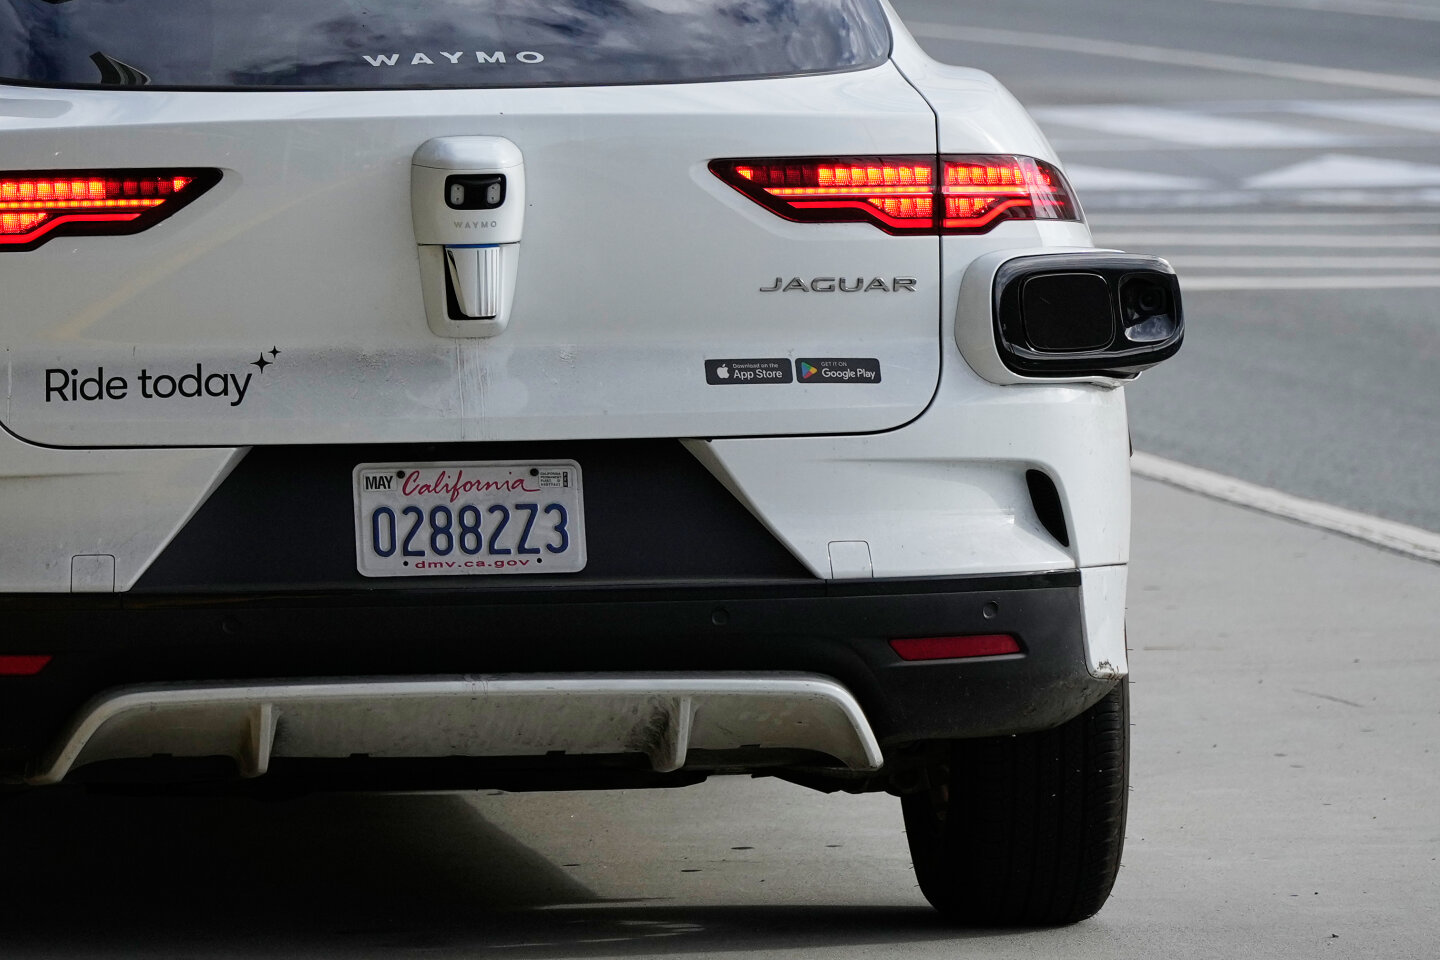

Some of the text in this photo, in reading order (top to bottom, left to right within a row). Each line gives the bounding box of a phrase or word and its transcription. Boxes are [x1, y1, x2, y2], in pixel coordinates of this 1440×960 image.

[362, 51, 545, 67] WAYMO
[453, 220, 497, 229] WAYMO
[760, 277, 918, 292] JAGUAR
[733, 369, 783, 380] App Store
[821, 368, 876, 380] Google Play
[44, 363, 253, 407] Ride today
[365, 475, 393, 490] MAY
[402, 470, 541, 502] California
[371, 503, 569, 558] 02882Z3
[415, 559, 530, 569] dmv.ca.gov
